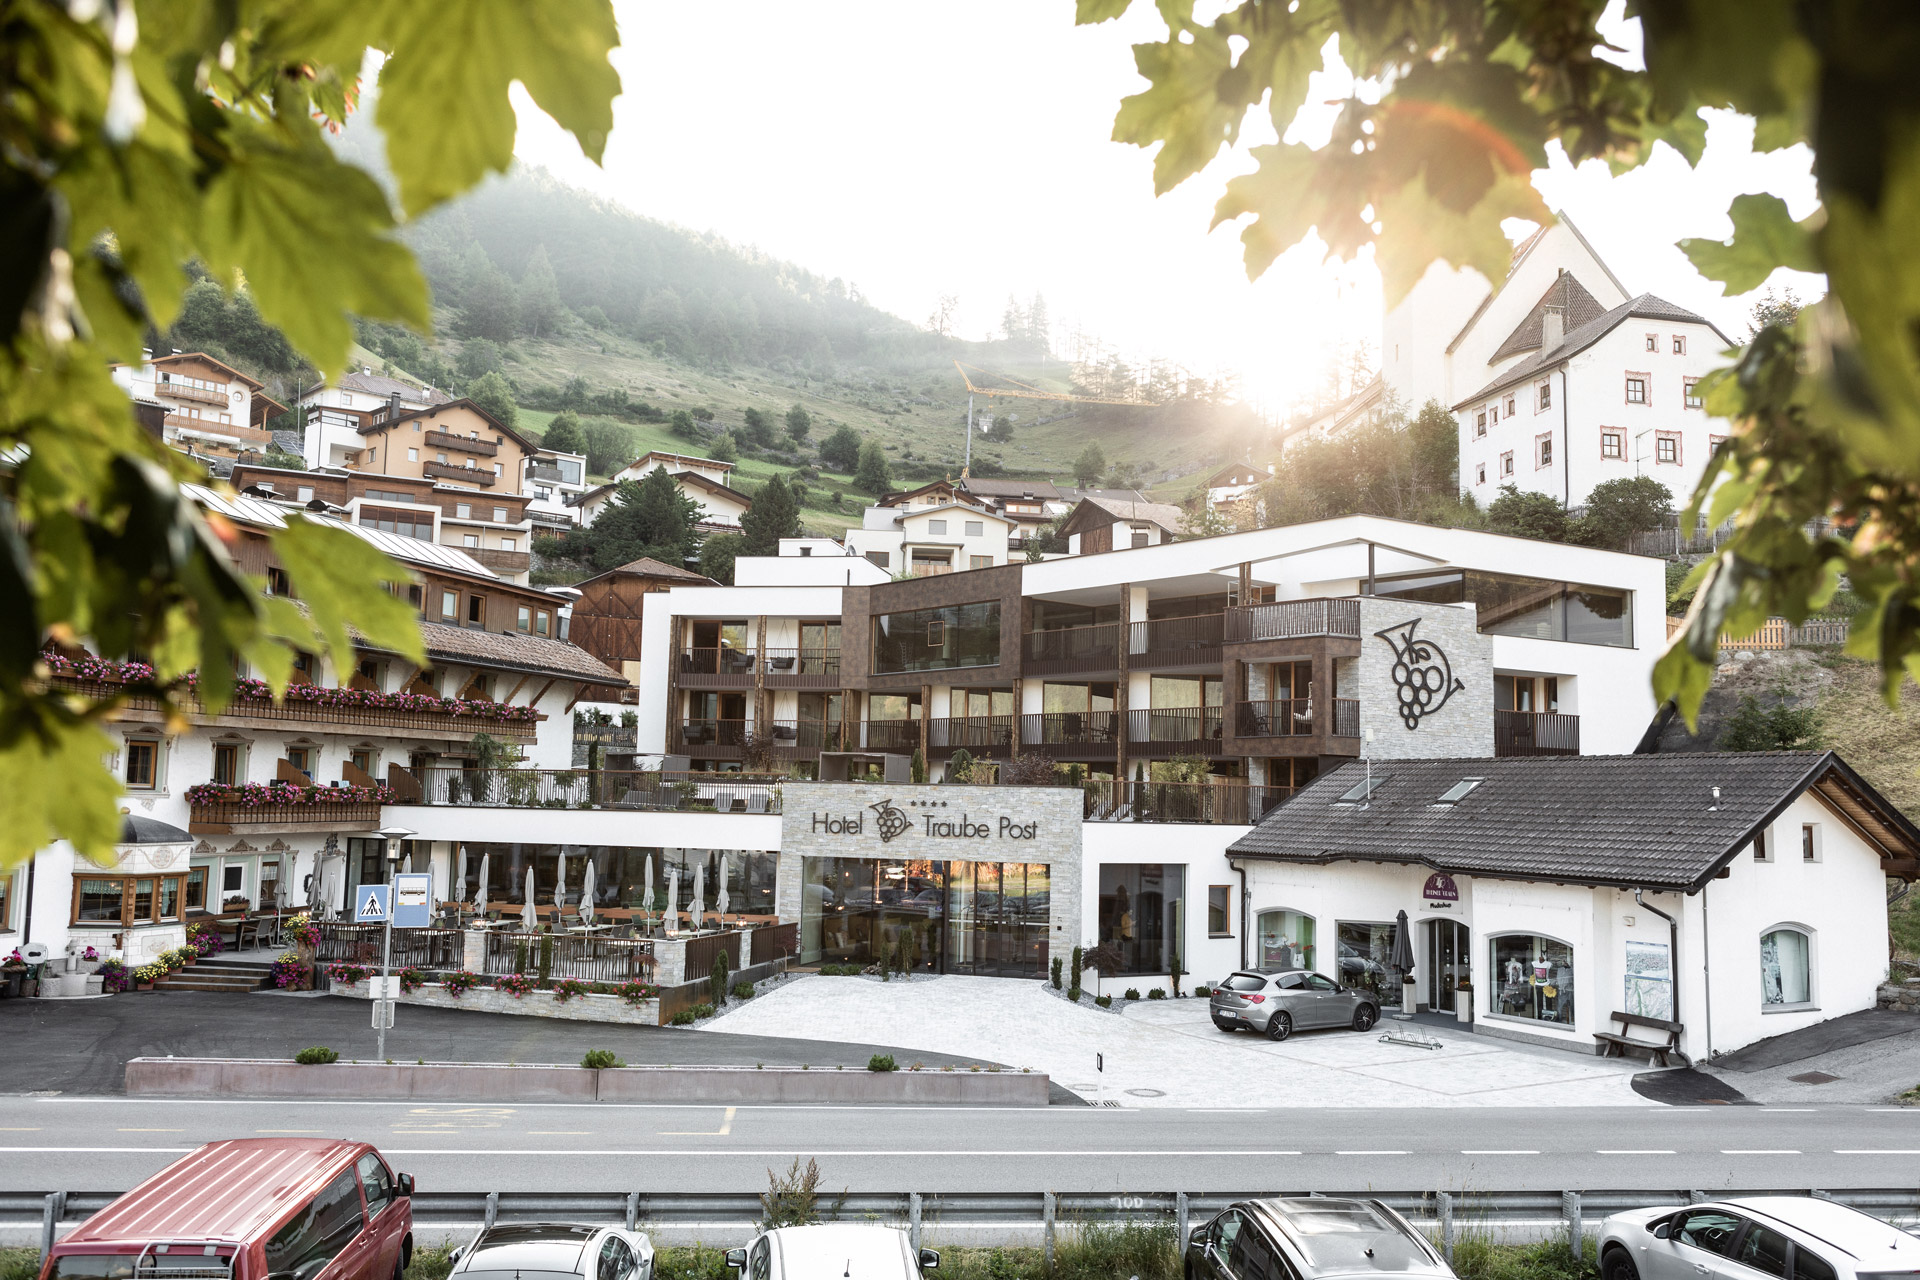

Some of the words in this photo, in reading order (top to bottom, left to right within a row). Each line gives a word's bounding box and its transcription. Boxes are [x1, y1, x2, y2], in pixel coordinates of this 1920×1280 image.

[813, 812, 862, 834] Hotel
[922, 814, 989, 838] Traube
[1000, 817, 1037, 839] Post
